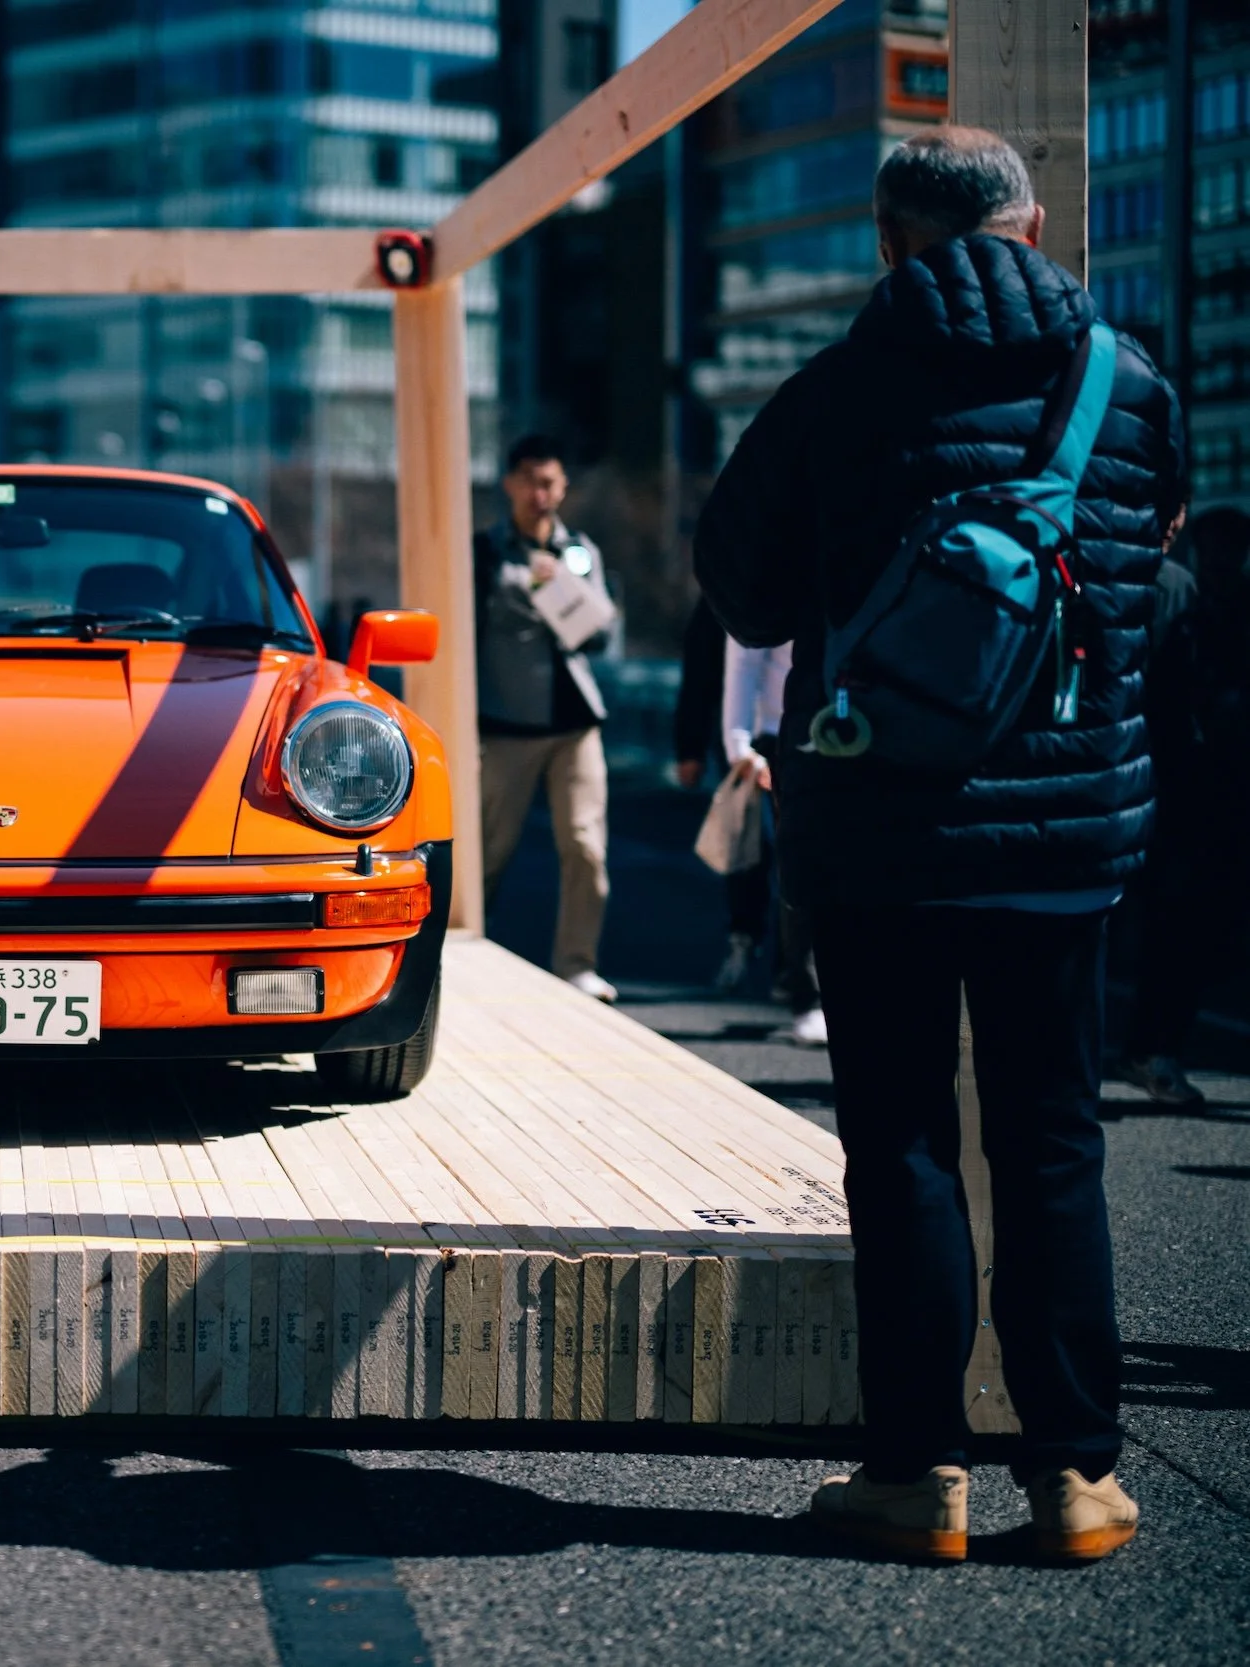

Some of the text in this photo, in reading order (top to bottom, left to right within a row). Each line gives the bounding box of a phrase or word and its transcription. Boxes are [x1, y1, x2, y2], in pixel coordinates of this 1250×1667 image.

[691, 1208, 757, 1227] 911
[38, 1309, 47, 1340] 2x10-20
[120, 1308, 129, 1340] 2x10-20
[229, 1321, 238, 1352] 2x10-20
[452, 1323, 461, 1355] 2x10-20
[482, 1320, 492, 1352] 2x10-20
[592, 1324, 601, 1355] 2x10-20
[565, 1326, 574, 1357] 2x10-20
[703, 1329, 712, 1361] 2x10-20
